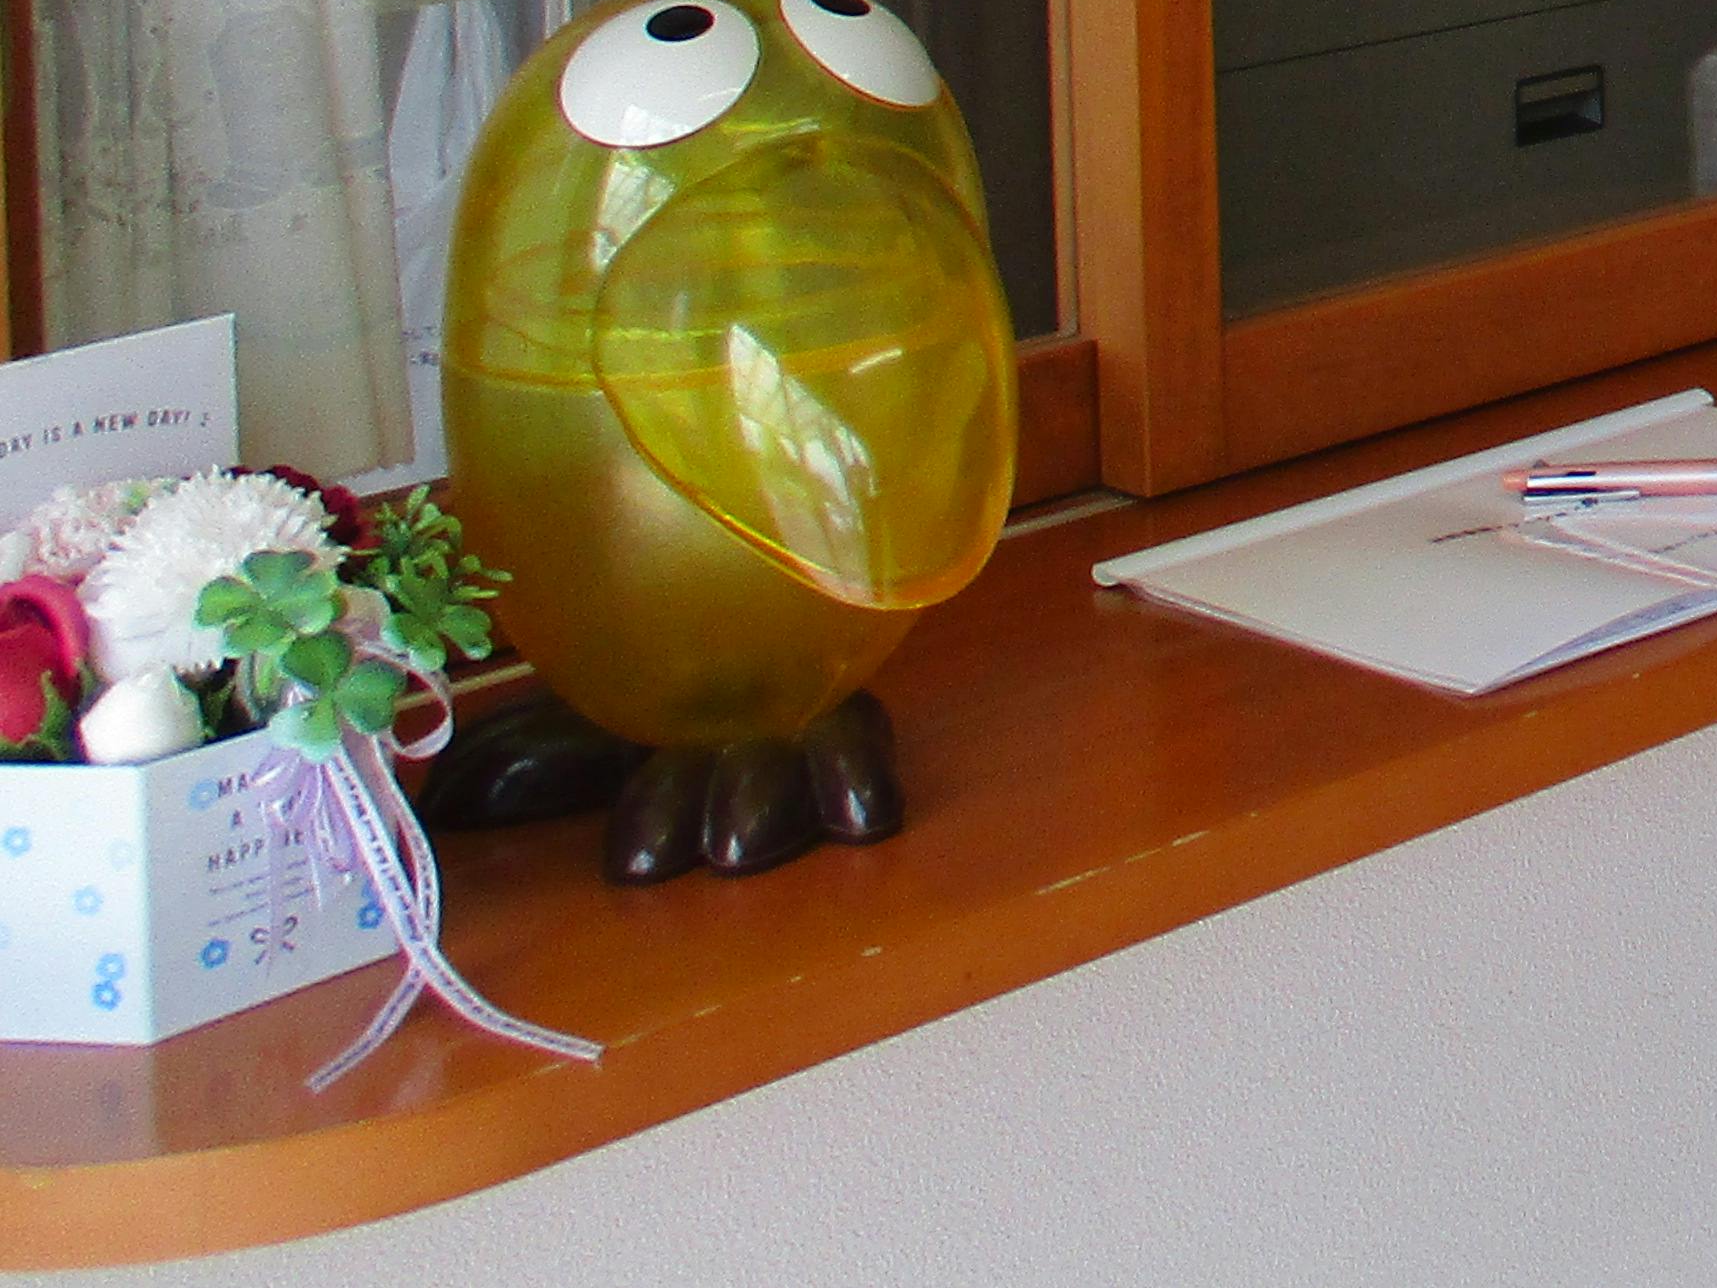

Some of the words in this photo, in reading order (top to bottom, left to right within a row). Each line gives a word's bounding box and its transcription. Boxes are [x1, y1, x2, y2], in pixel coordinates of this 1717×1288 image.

[43, 426, 62, 444] IS
[72, 421, 84, 437] A
[95, 412, 138, 433] NEW
[231, 809, 242, 827] A
